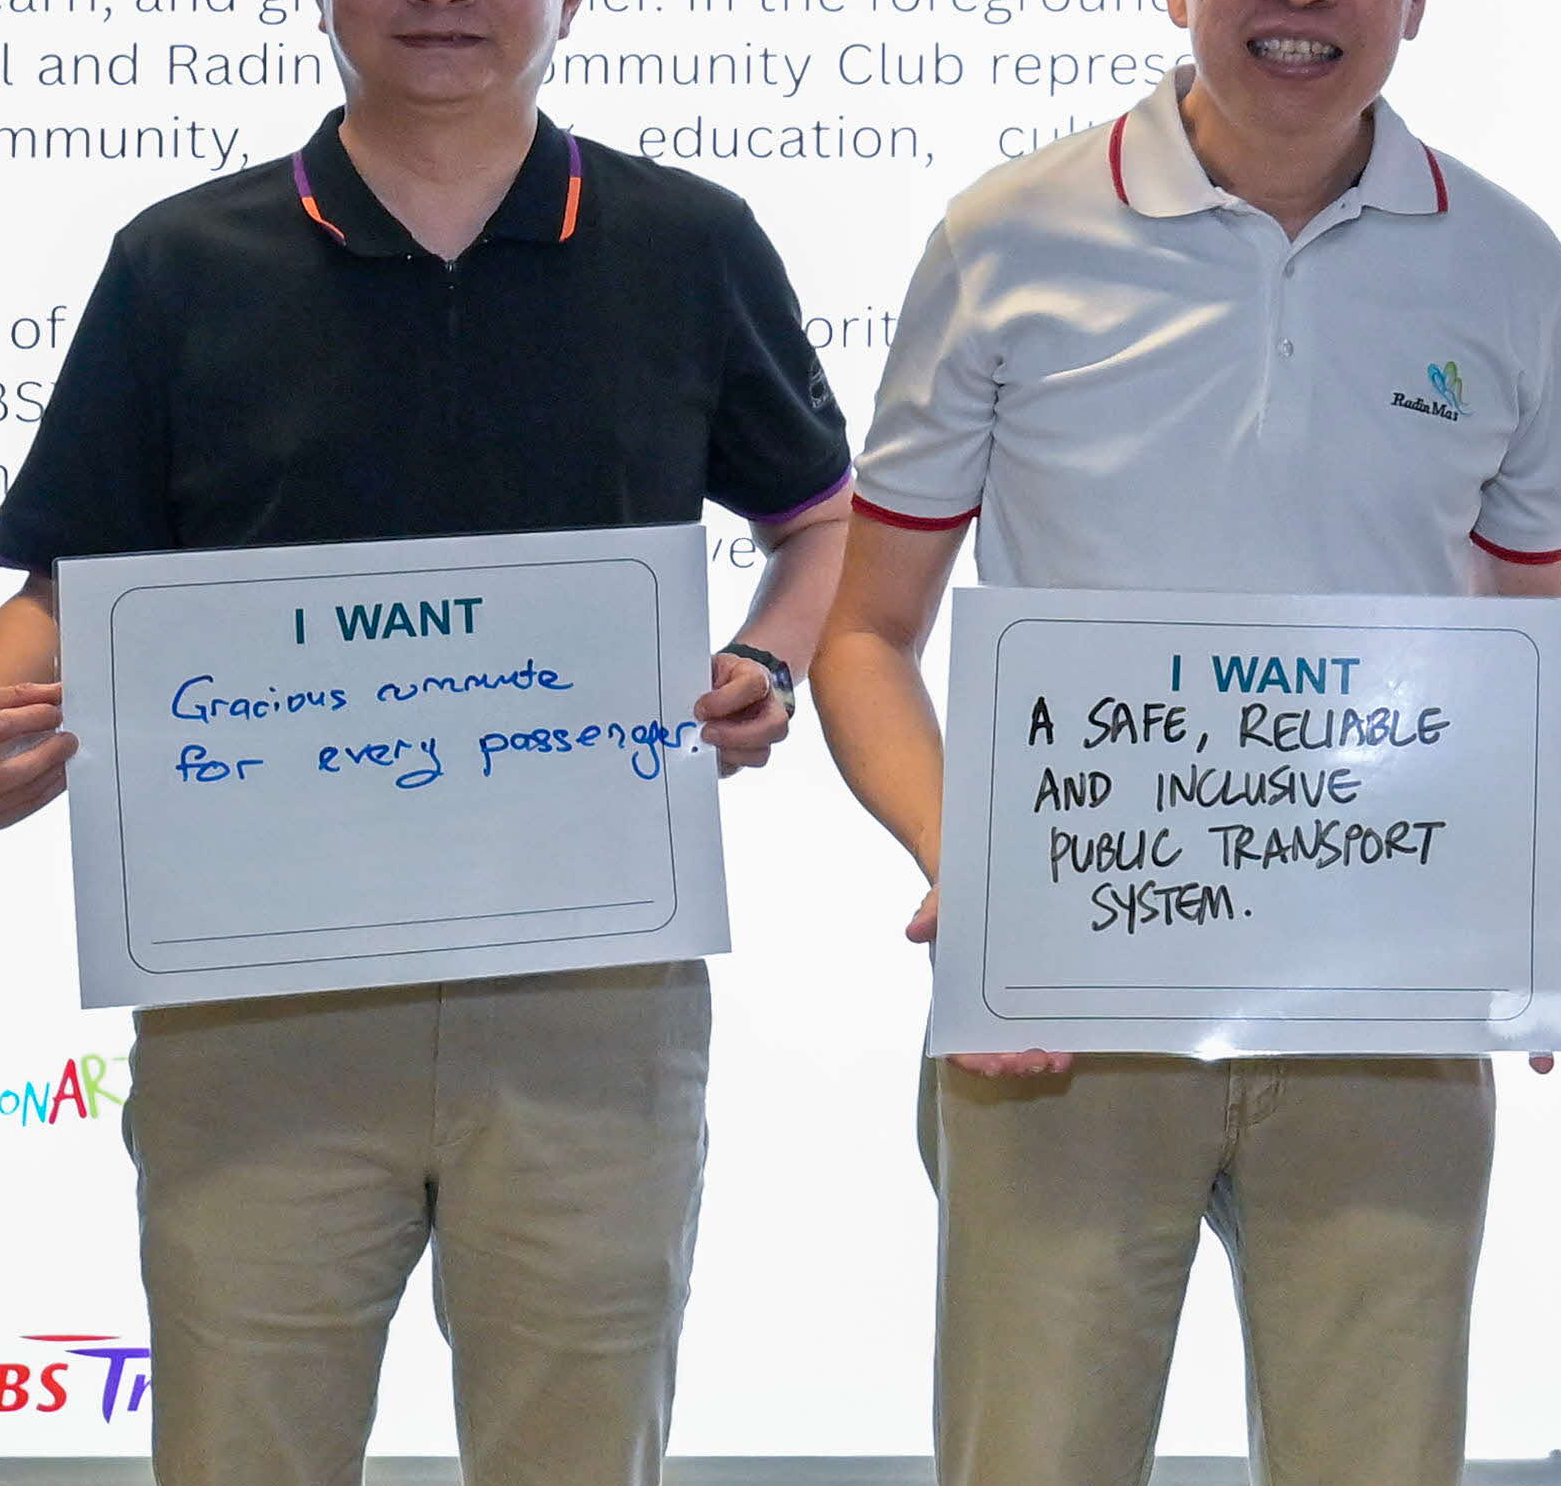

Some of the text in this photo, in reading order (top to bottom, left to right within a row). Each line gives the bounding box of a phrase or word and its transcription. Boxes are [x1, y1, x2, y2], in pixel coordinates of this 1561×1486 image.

[38, 41, 138, 87] and
[168, 41, 321, 86] Radin
[838, 41, 964, 86] Club
[634, 114, 934, 169] education,
[10, 305, 67, 350] of
[1390, 392, 1459, 422] Radin Mas
[294, 597, 484, 645] I WANT
[171, 675, 349, 724] Gracious
[1171, 655, 1361, 696] I WANT
[1027, 696, 1451, 755] A SAFE, RELIABLE
[174, 743, 264, 783] for
[317, 738, 444, 790] every
[1033, 766, 1363, 814] AND INCLUSIVE
[1048, 820, 1447, 884] PUBLIC TRANSPORT
[1090, 883, 1254, 935] SYSTEM.
